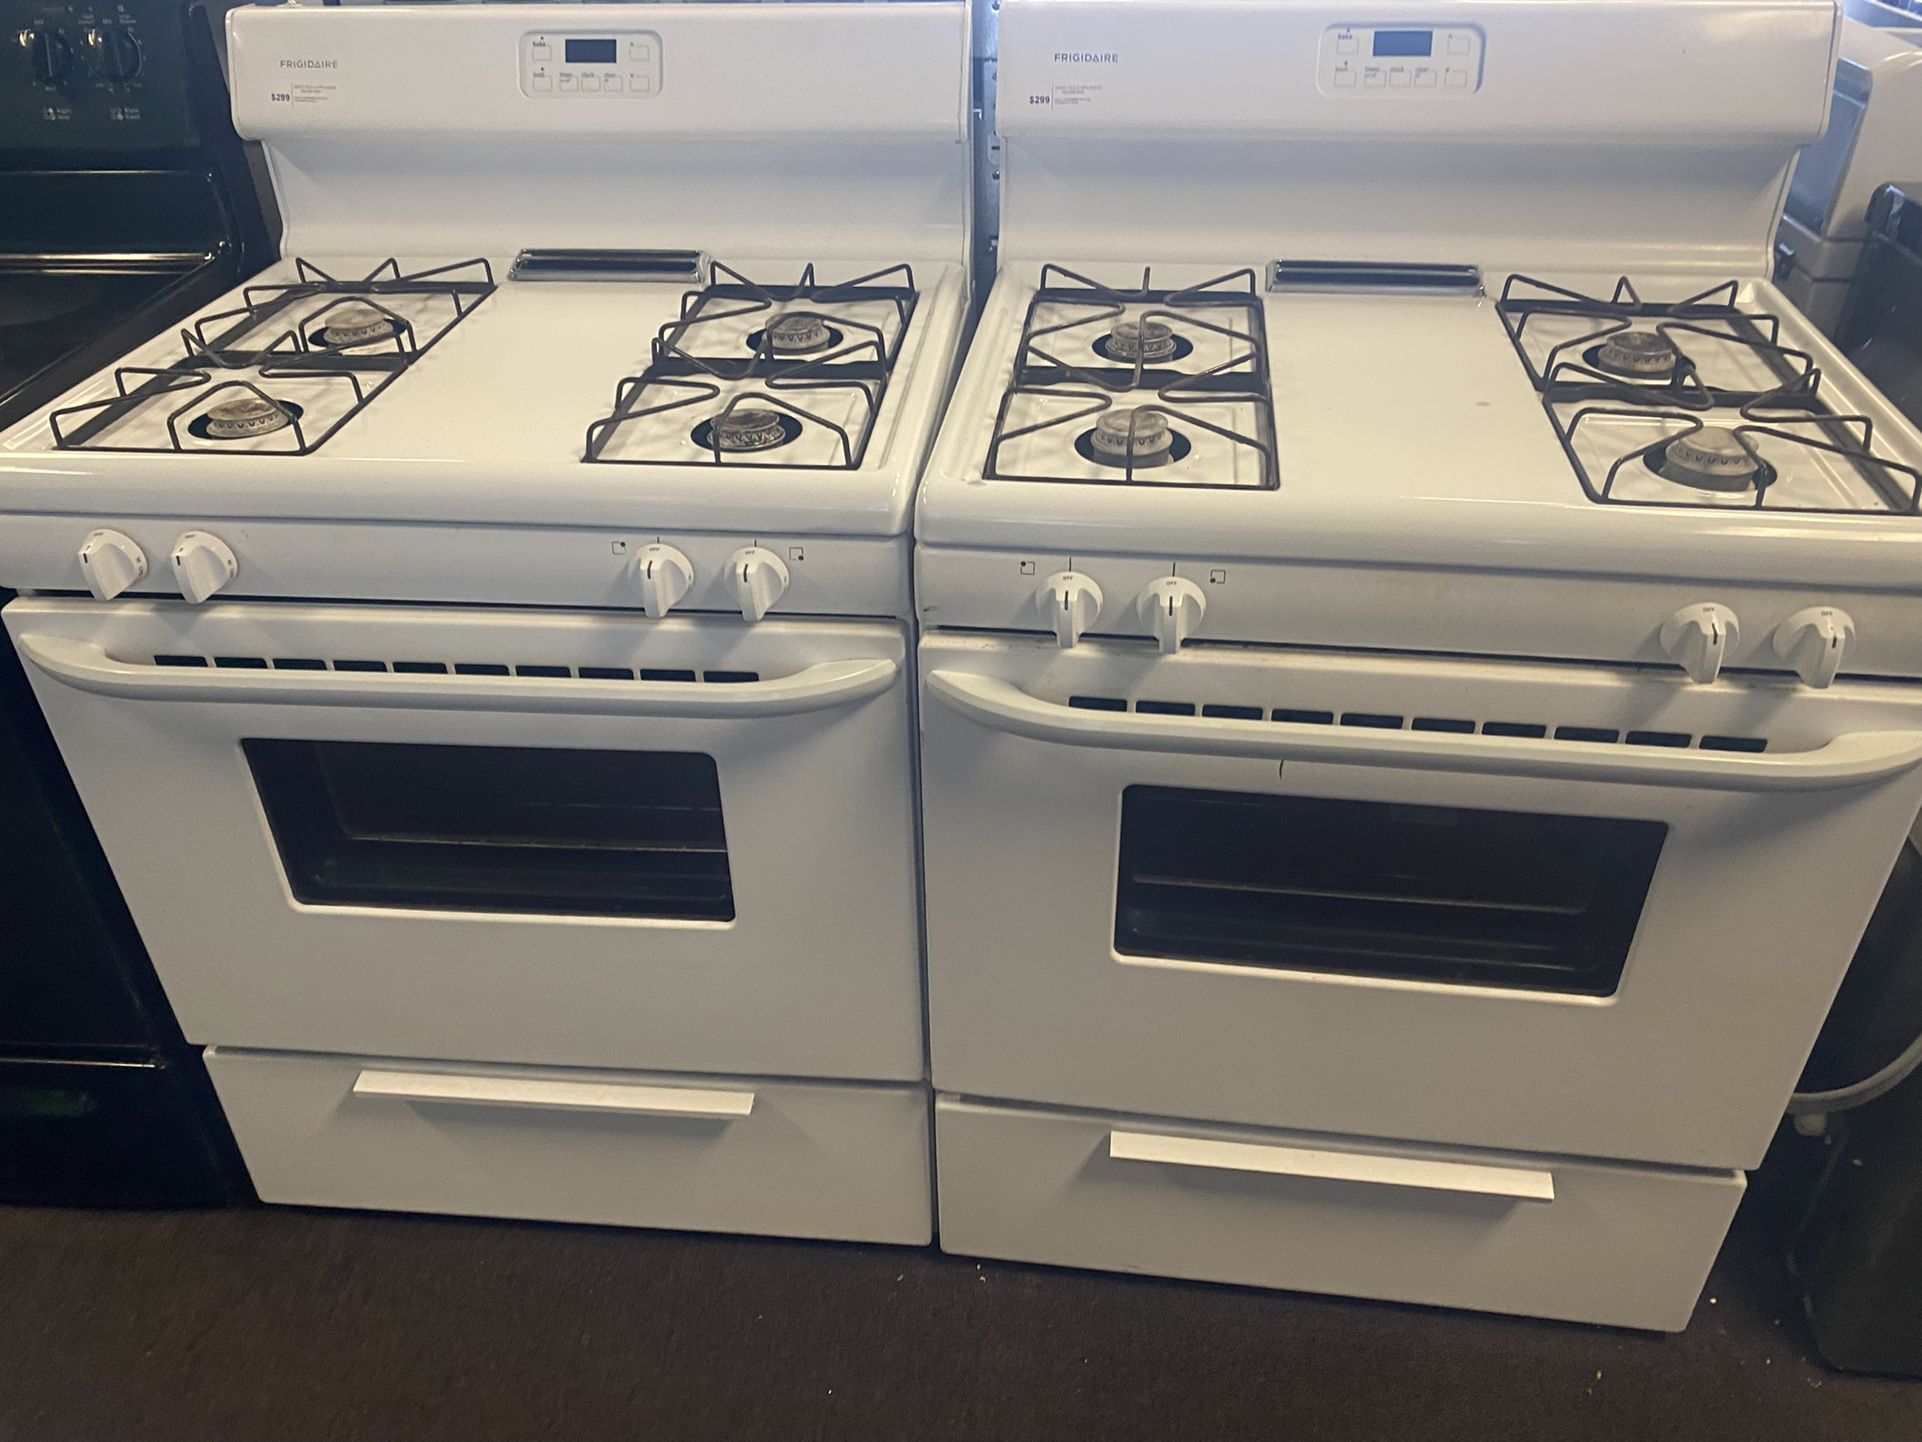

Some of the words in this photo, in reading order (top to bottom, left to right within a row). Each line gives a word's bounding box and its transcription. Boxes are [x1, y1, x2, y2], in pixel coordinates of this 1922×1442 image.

[1054, 52, 1119, 63] FRIGIDAIRE
[280, 59, 339, 69] FRIGIDAIRE
[271, 93, 290, 102] $299
[1029, 95, 1050, 105] $299
